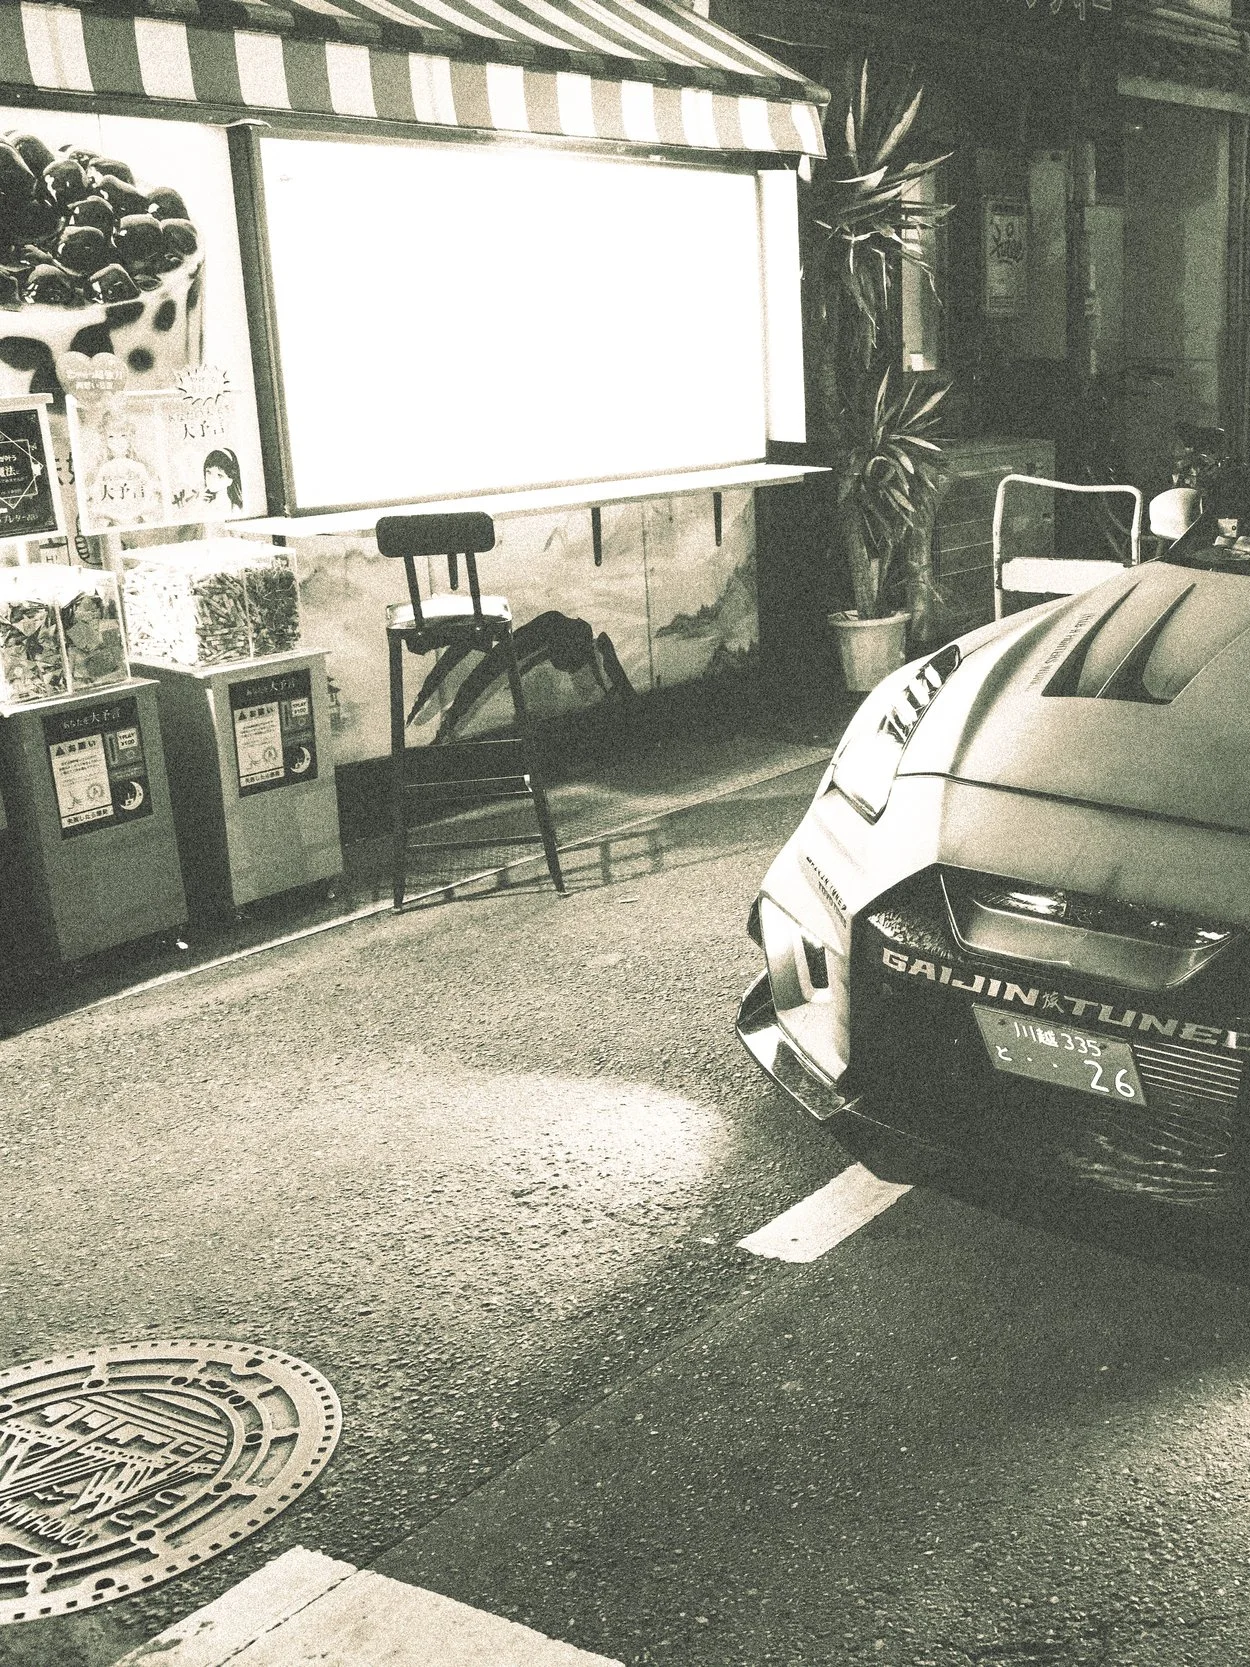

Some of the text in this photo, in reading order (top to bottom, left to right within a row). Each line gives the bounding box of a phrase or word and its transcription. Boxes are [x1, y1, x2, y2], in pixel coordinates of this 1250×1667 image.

[882, 947, 1040, 1007] GAIJIN
[996, 1045, 1013, 1062] と
[1014, 1021, 1101, 1057] 川越 335
